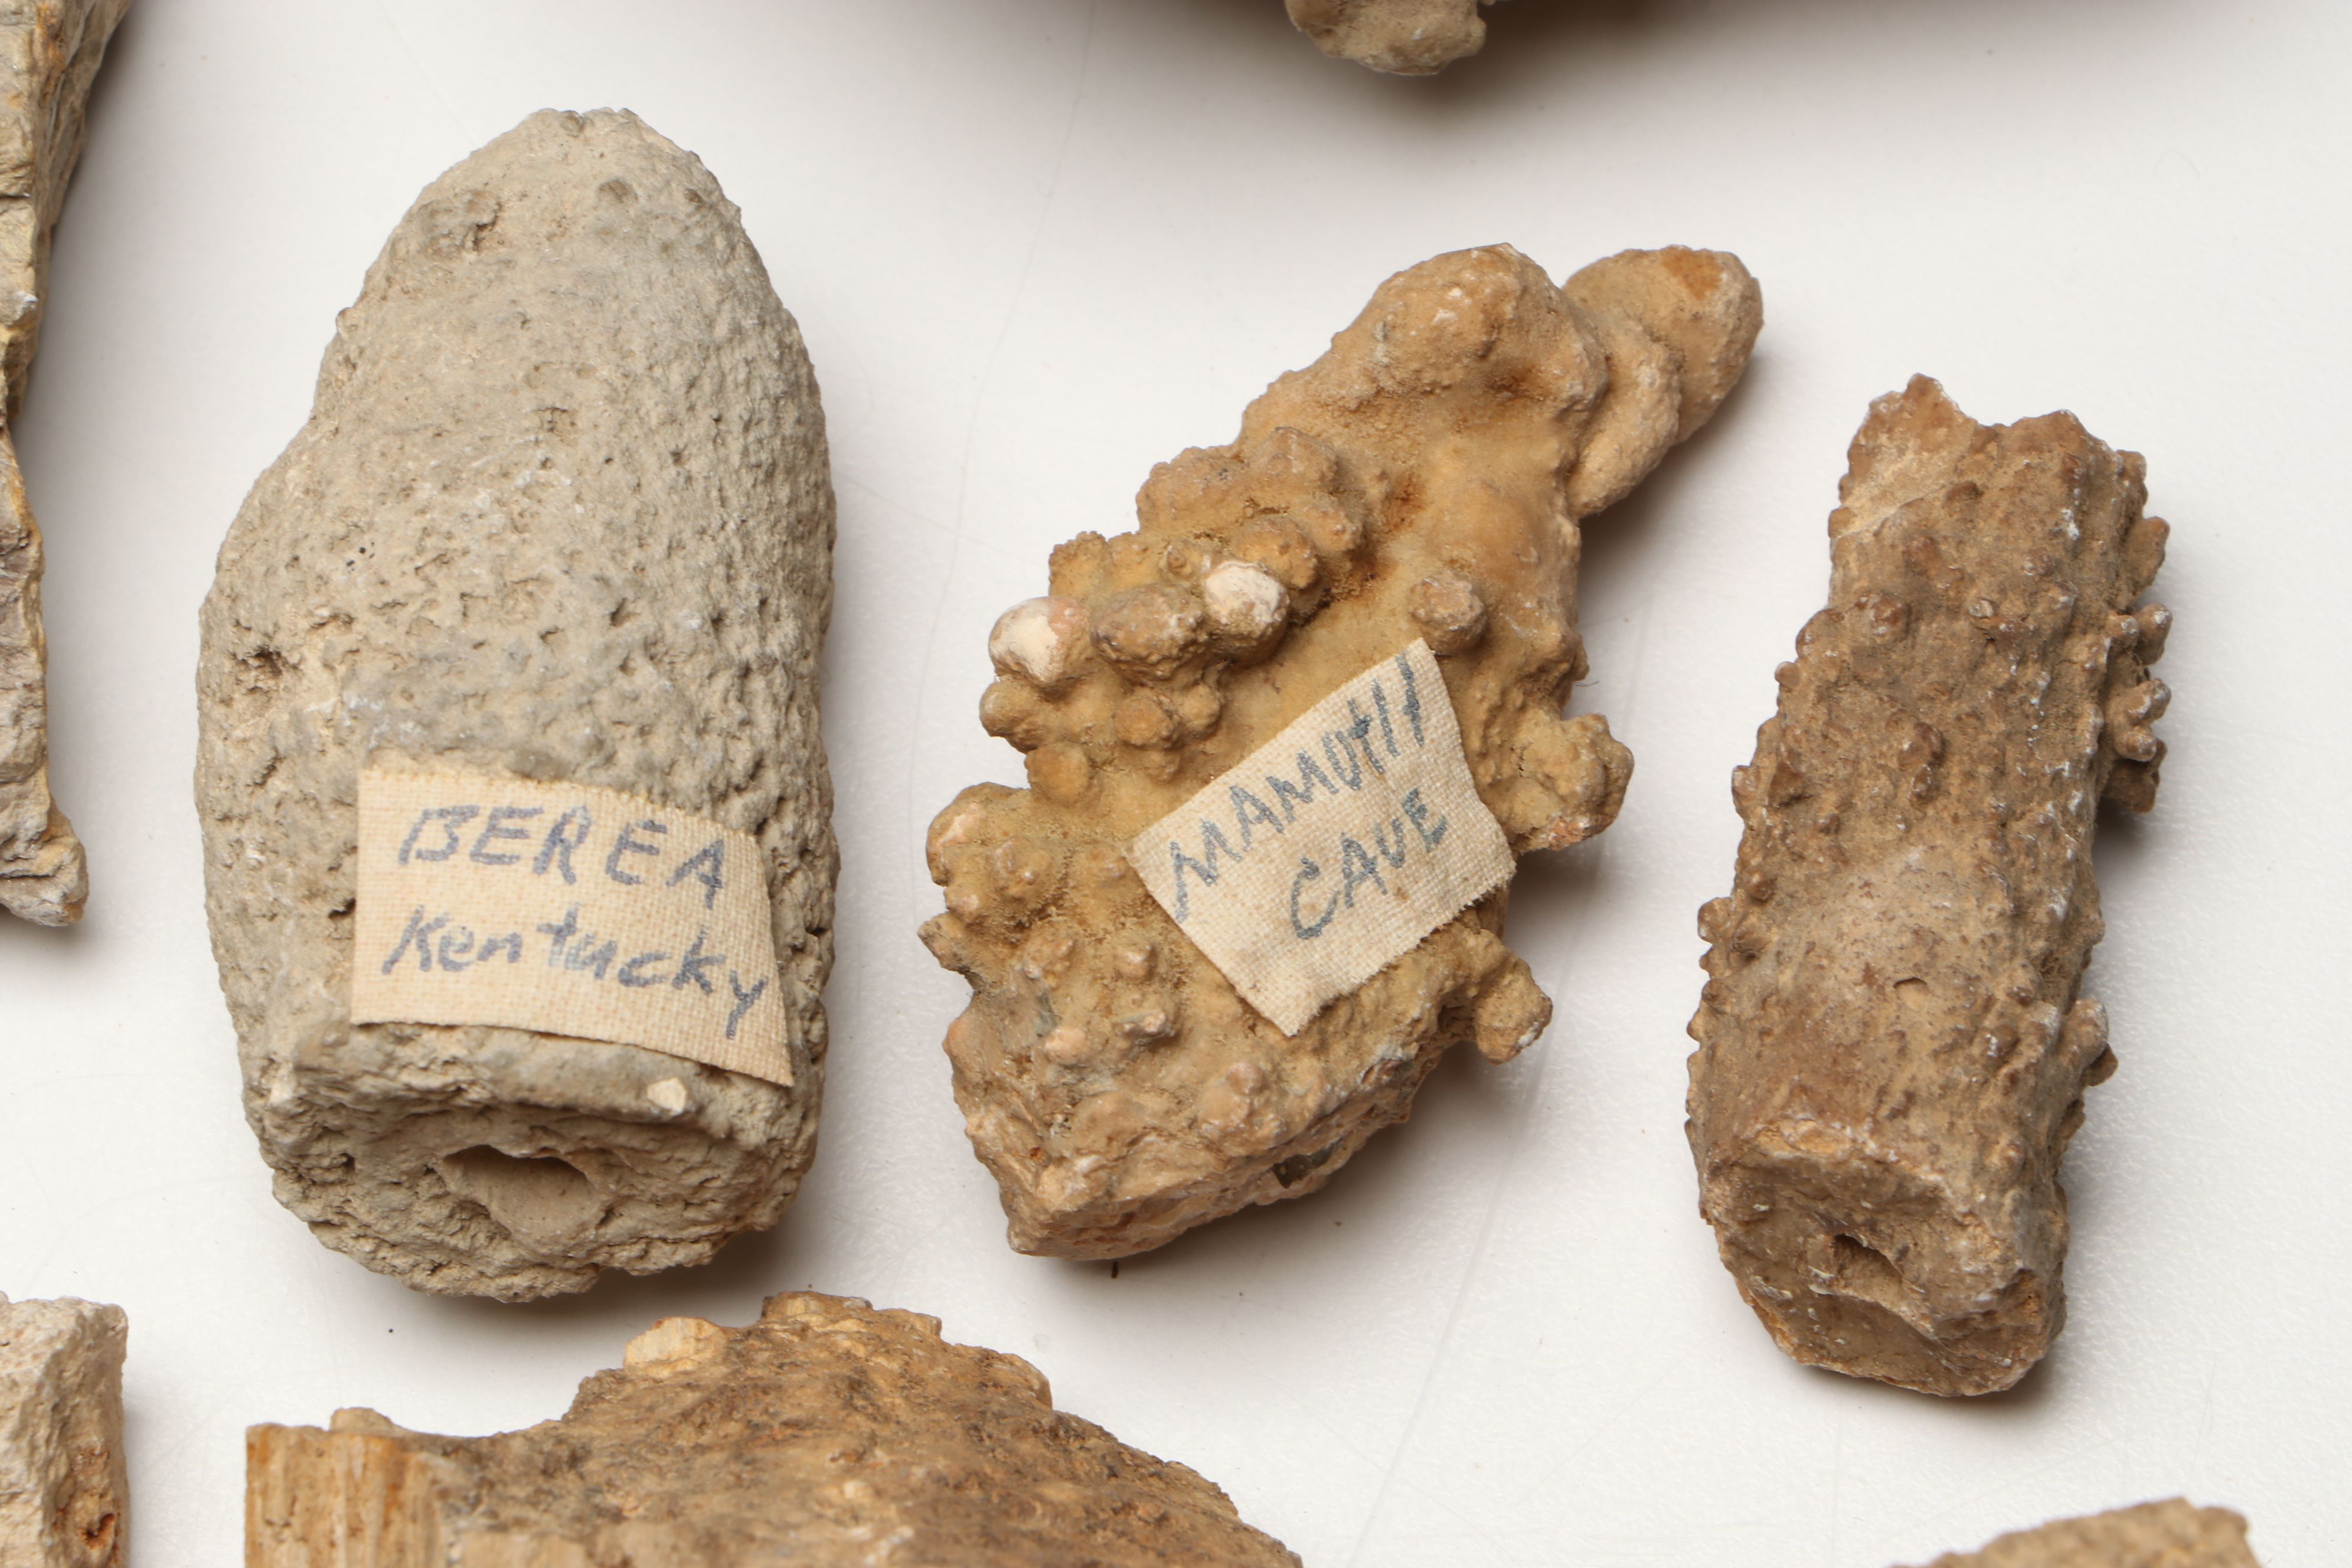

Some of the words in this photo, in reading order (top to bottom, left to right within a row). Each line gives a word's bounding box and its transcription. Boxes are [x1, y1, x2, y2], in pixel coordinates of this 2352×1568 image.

[398, 805, 726, 910] BEREA
[1290, 788, 1448, 939] CAVE
[381, 902, 768, 1039] Kentucky
